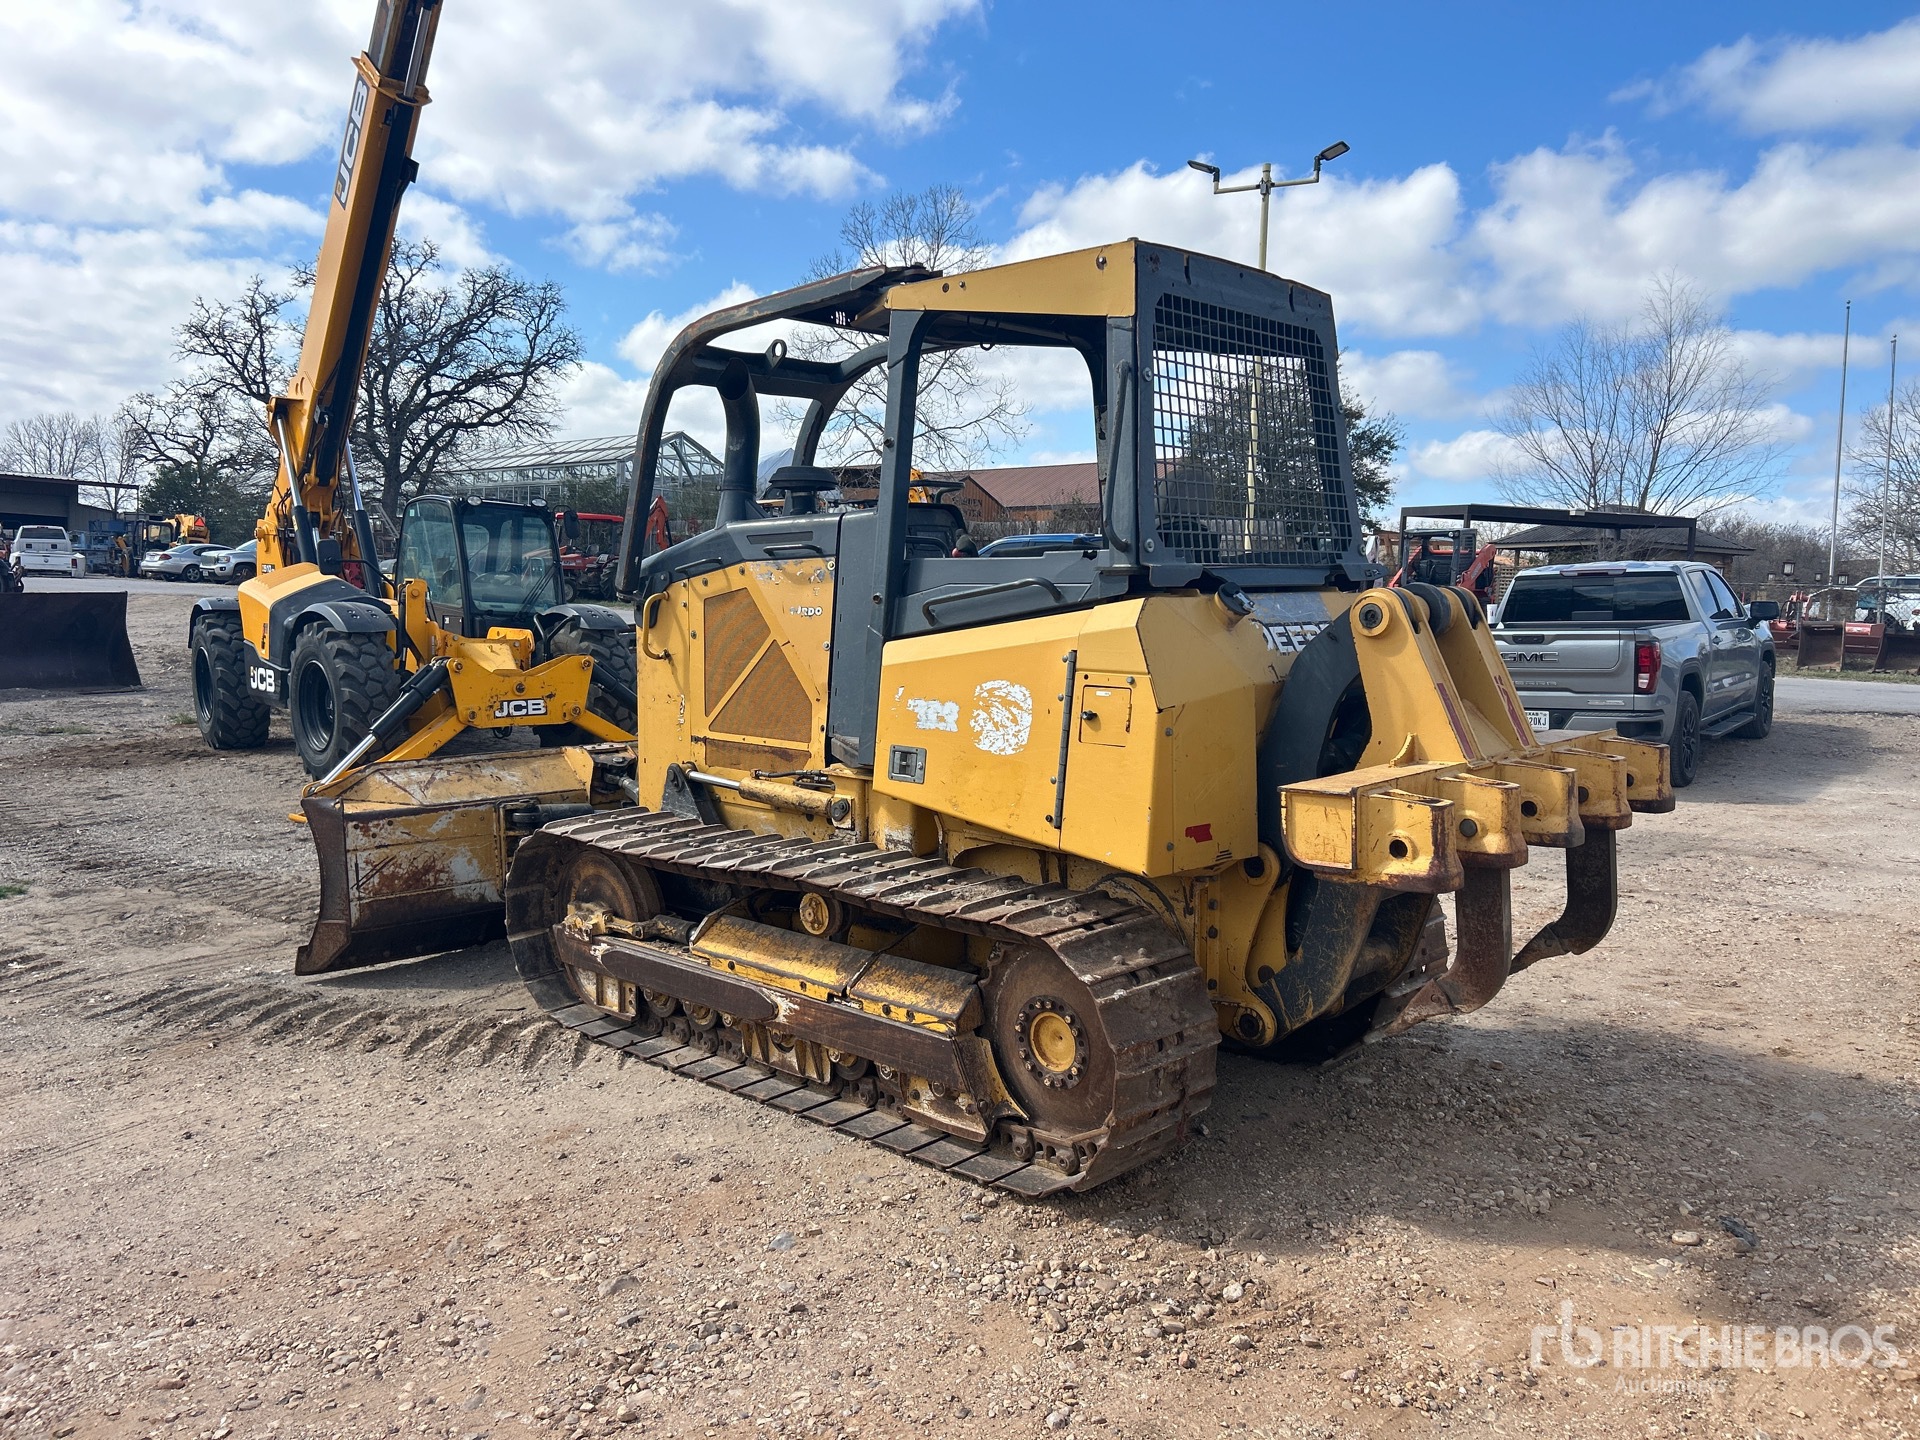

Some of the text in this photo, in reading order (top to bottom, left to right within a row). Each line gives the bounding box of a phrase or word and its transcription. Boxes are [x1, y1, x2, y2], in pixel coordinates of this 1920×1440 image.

[337, 79, 369, 205] JCB
[1500, 652, 1558, 662] GMC
[250, 666, 275, 693] JCB
[495, 699, 547, 717] JCB
[1527, 716, 1547, 726] 20KJ
